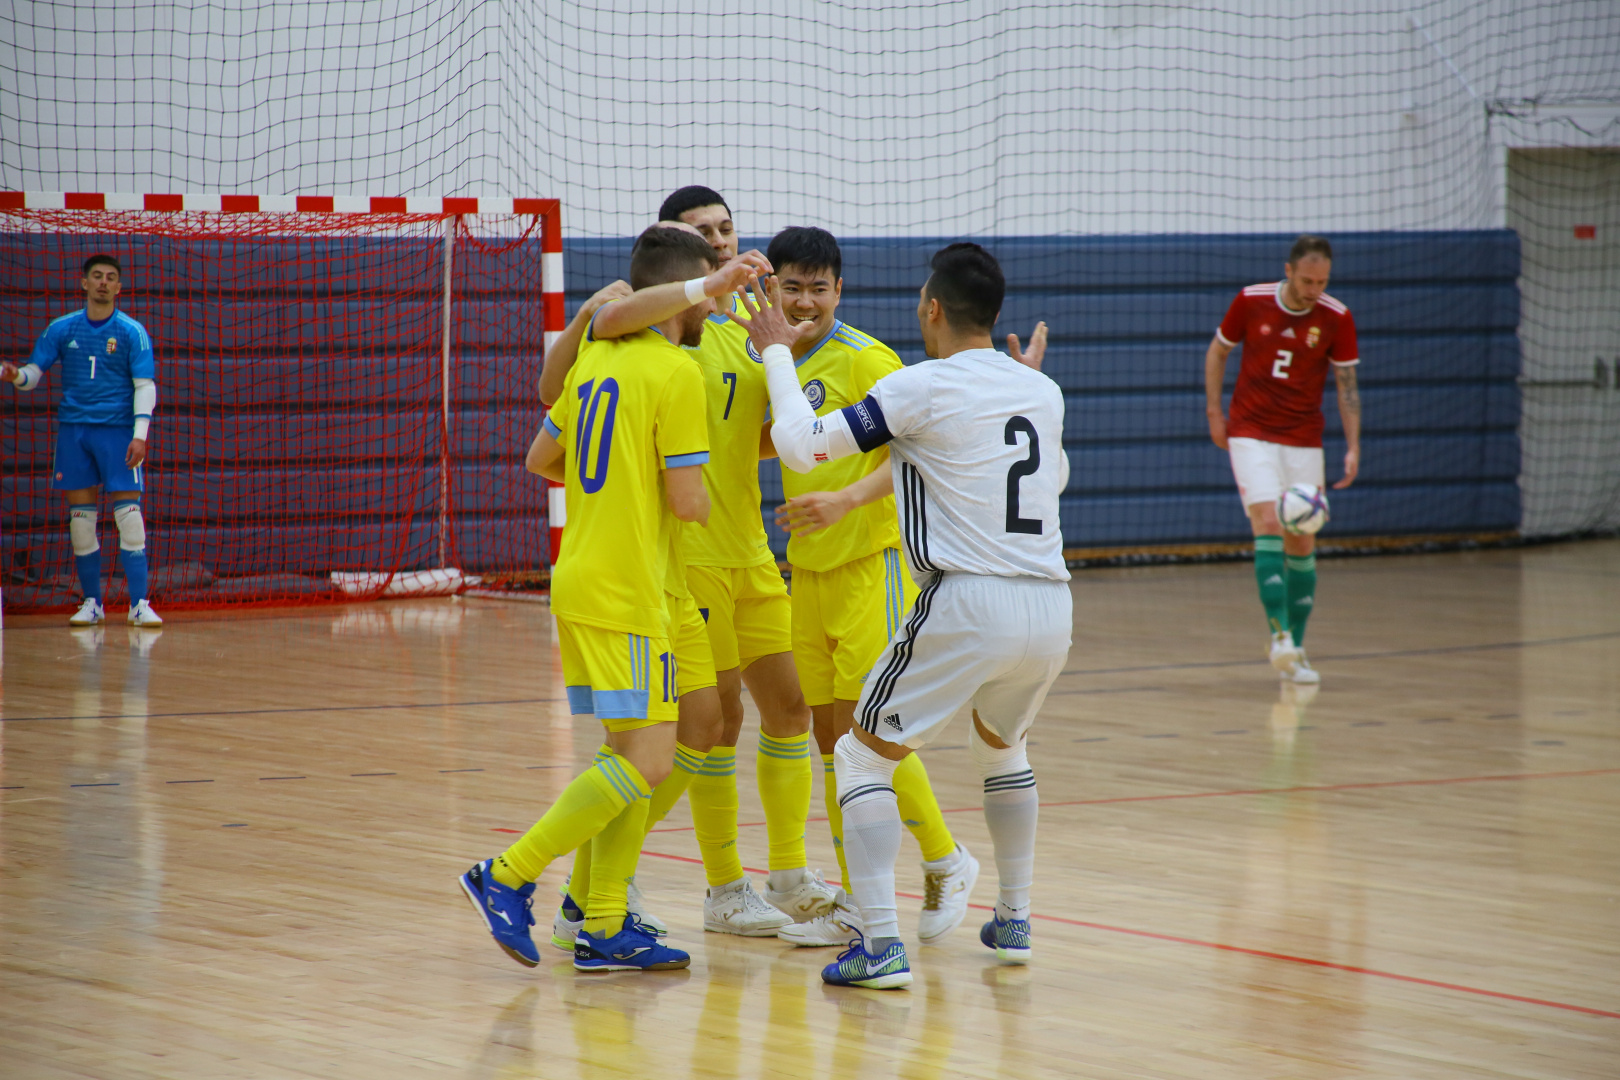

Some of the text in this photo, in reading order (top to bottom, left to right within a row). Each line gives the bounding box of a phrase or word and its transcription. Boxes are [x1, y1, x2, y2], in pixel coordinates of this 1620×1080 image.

[89, 356, 96, 379] 1
[1272, 350, 1293, 379] 2
[722, 372, 736, 420] 7
[576, 377, 619, 494] 10
[1004, 416, 1043, 535] 2
